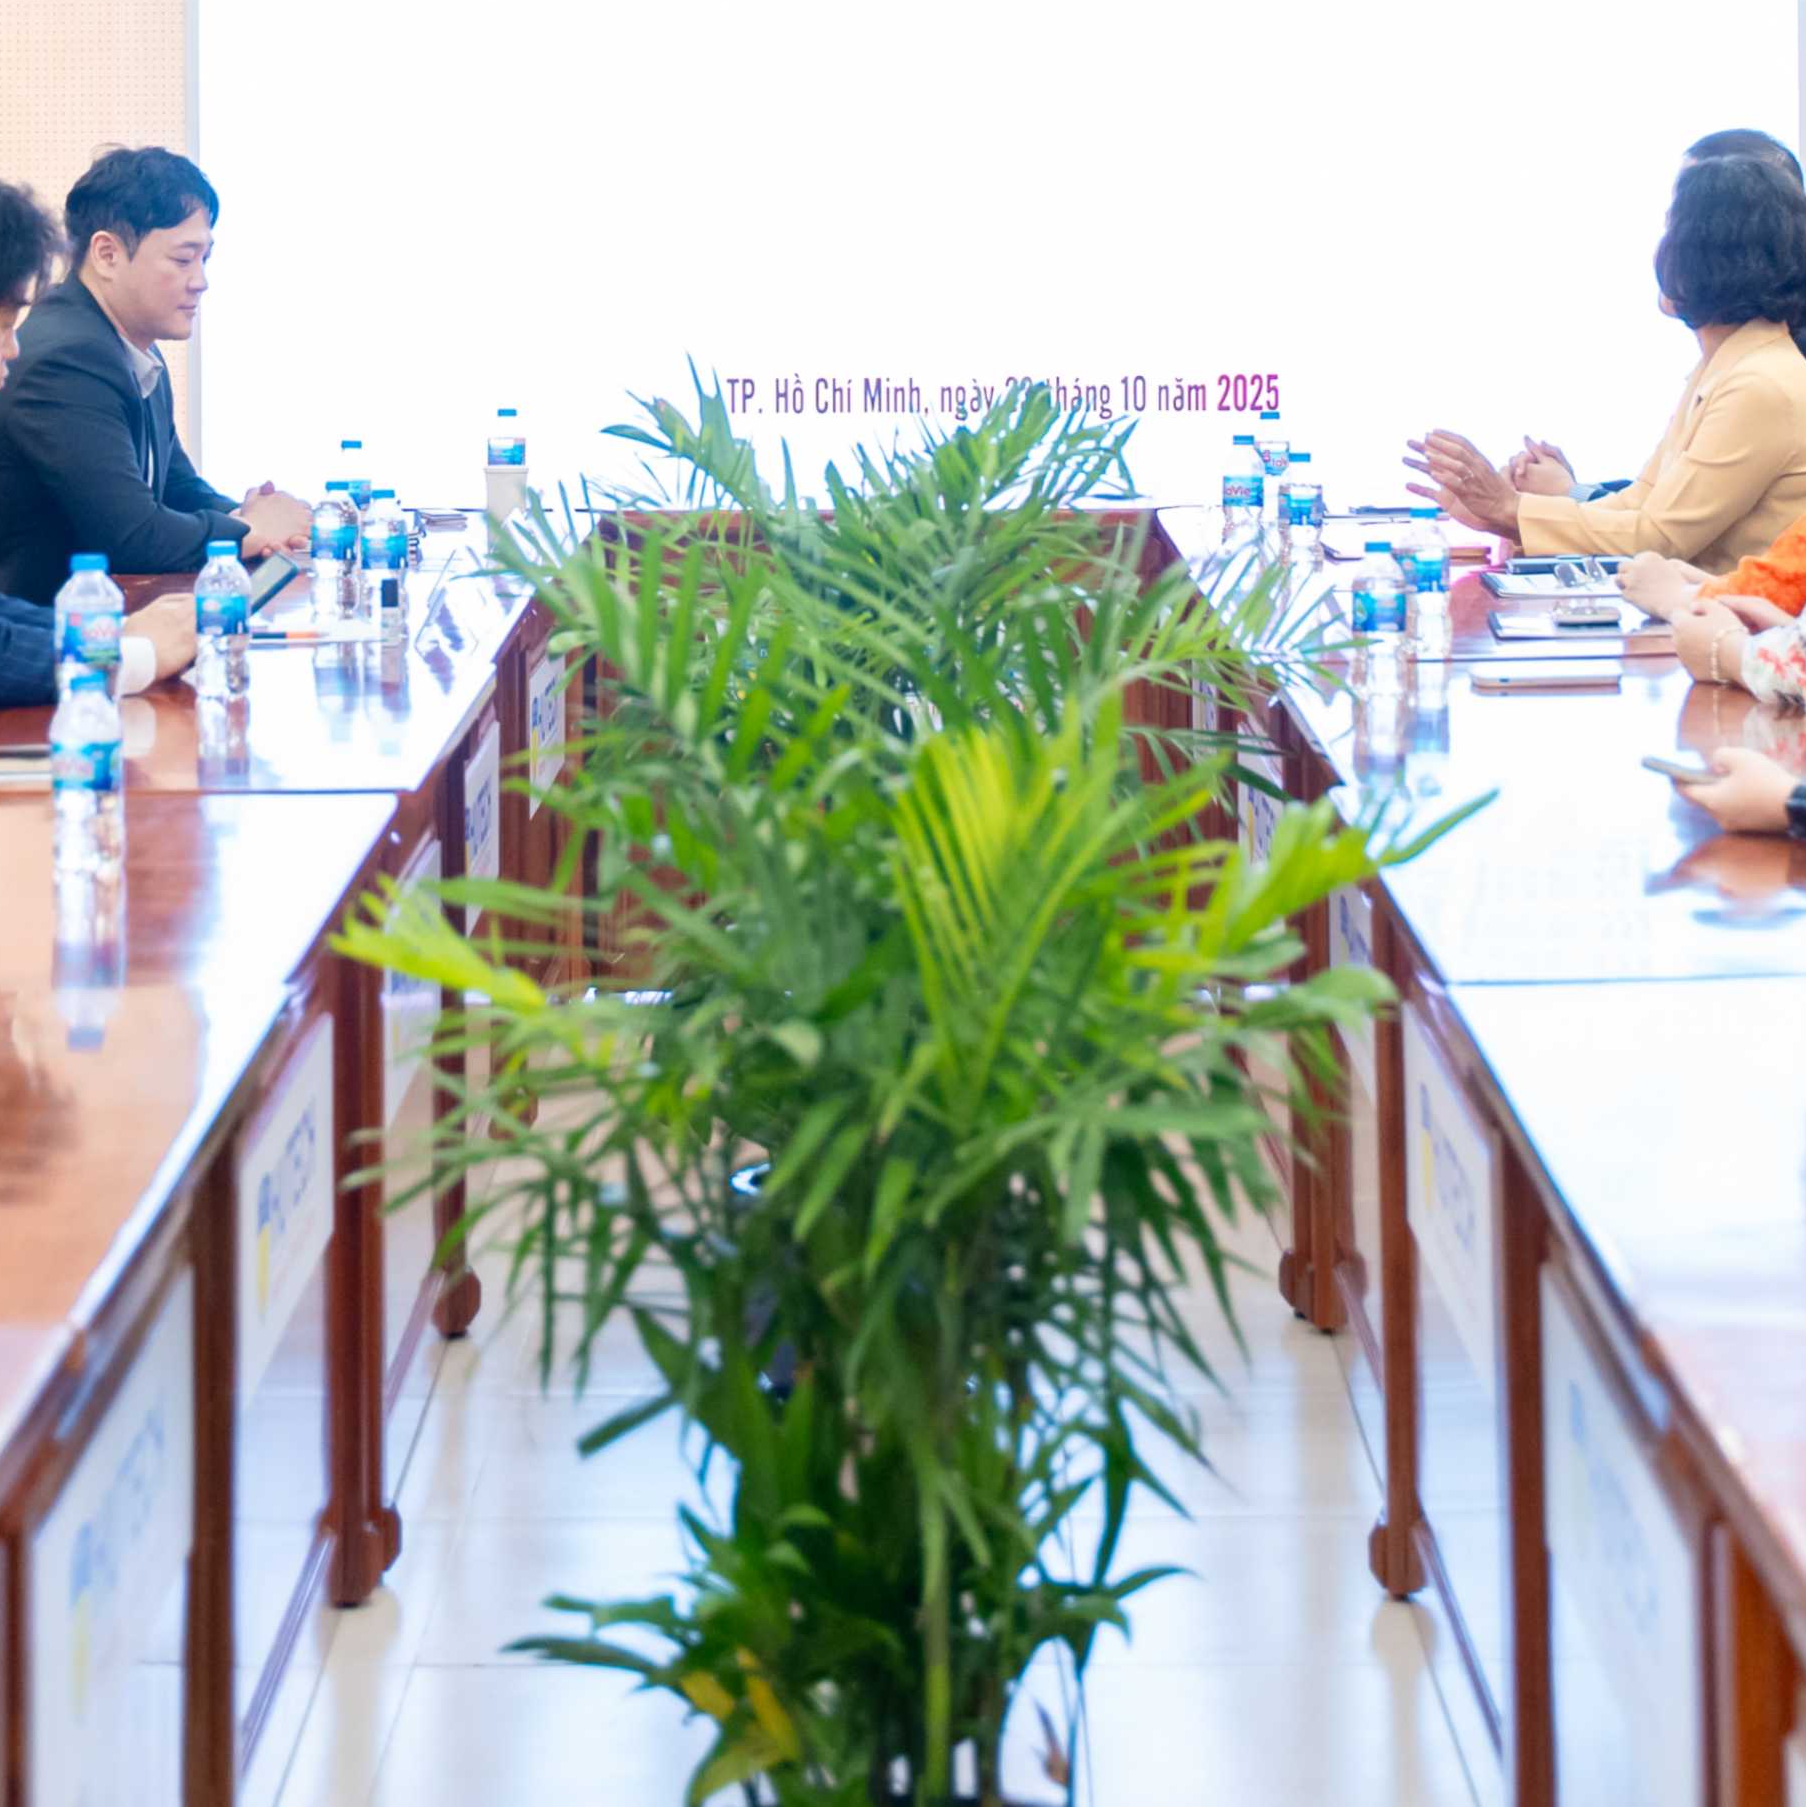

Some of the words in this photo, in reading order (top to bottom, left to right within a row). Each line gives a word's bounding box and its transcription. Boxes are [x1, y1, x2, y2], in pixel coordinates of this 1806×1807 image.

[726, 378, 764, 414] TP.
[774, 372, 805, 415] Hồ
[814, 377, 853, 415] Chí
[863, 377, 929, 415] Minh,
[1120, 375, 1147, 414] 10
[1157, 375, 1208, 414] năm
[1217, 373, 1281, 413] 2025
